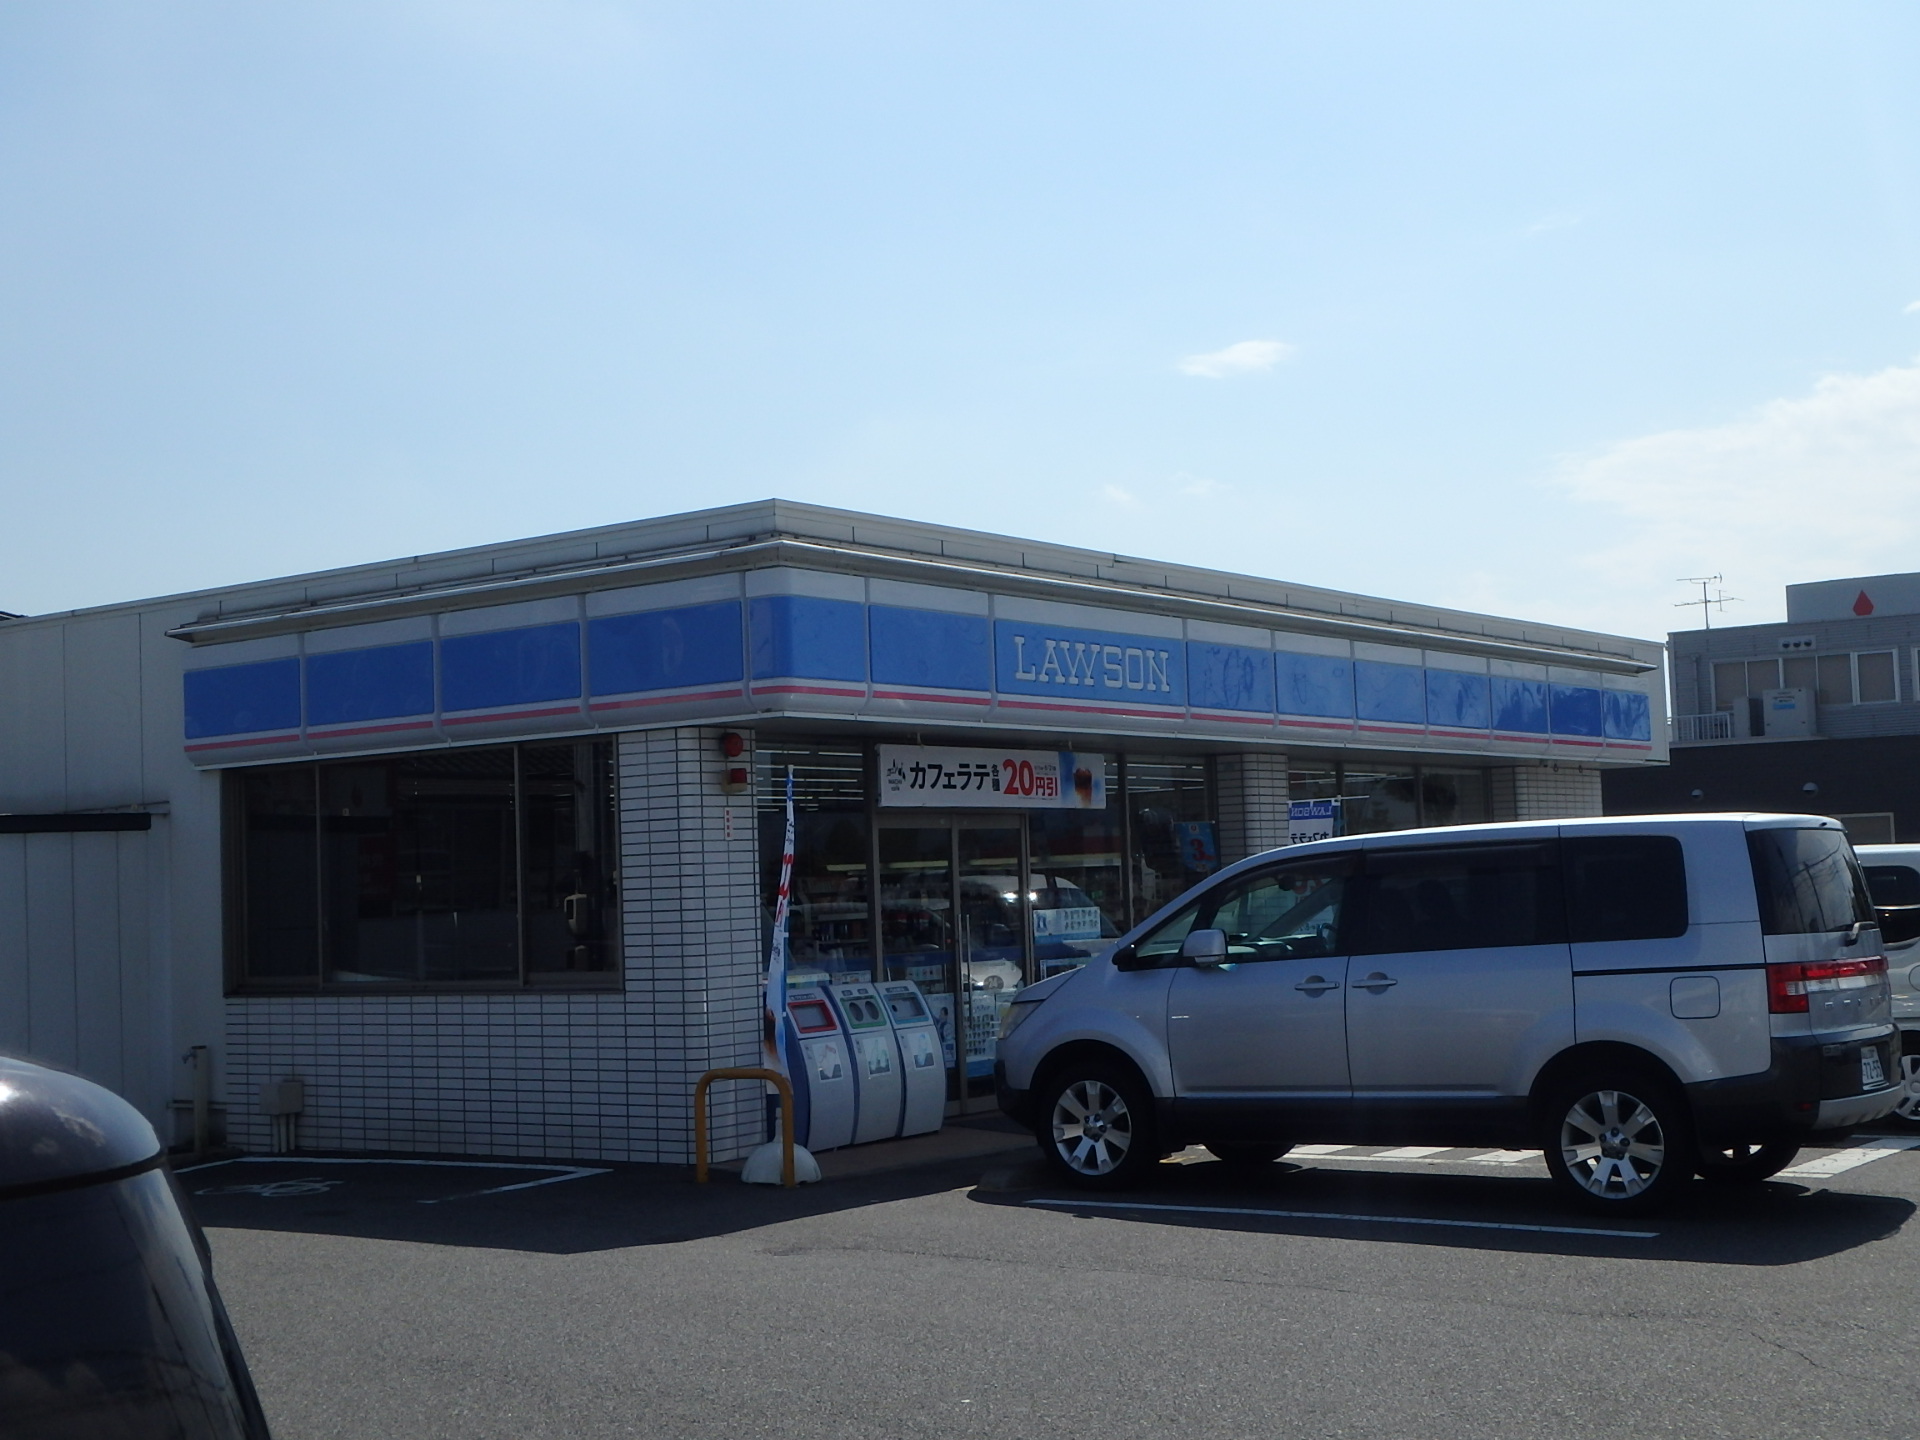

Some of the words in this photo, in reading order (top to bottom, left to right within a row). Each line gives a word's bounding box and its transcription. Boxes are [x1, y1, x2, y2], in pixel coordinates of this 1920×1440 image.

[1014, 635, 1171, 693] LAWSON
[909, 760, 990, 791] カフェラテ
